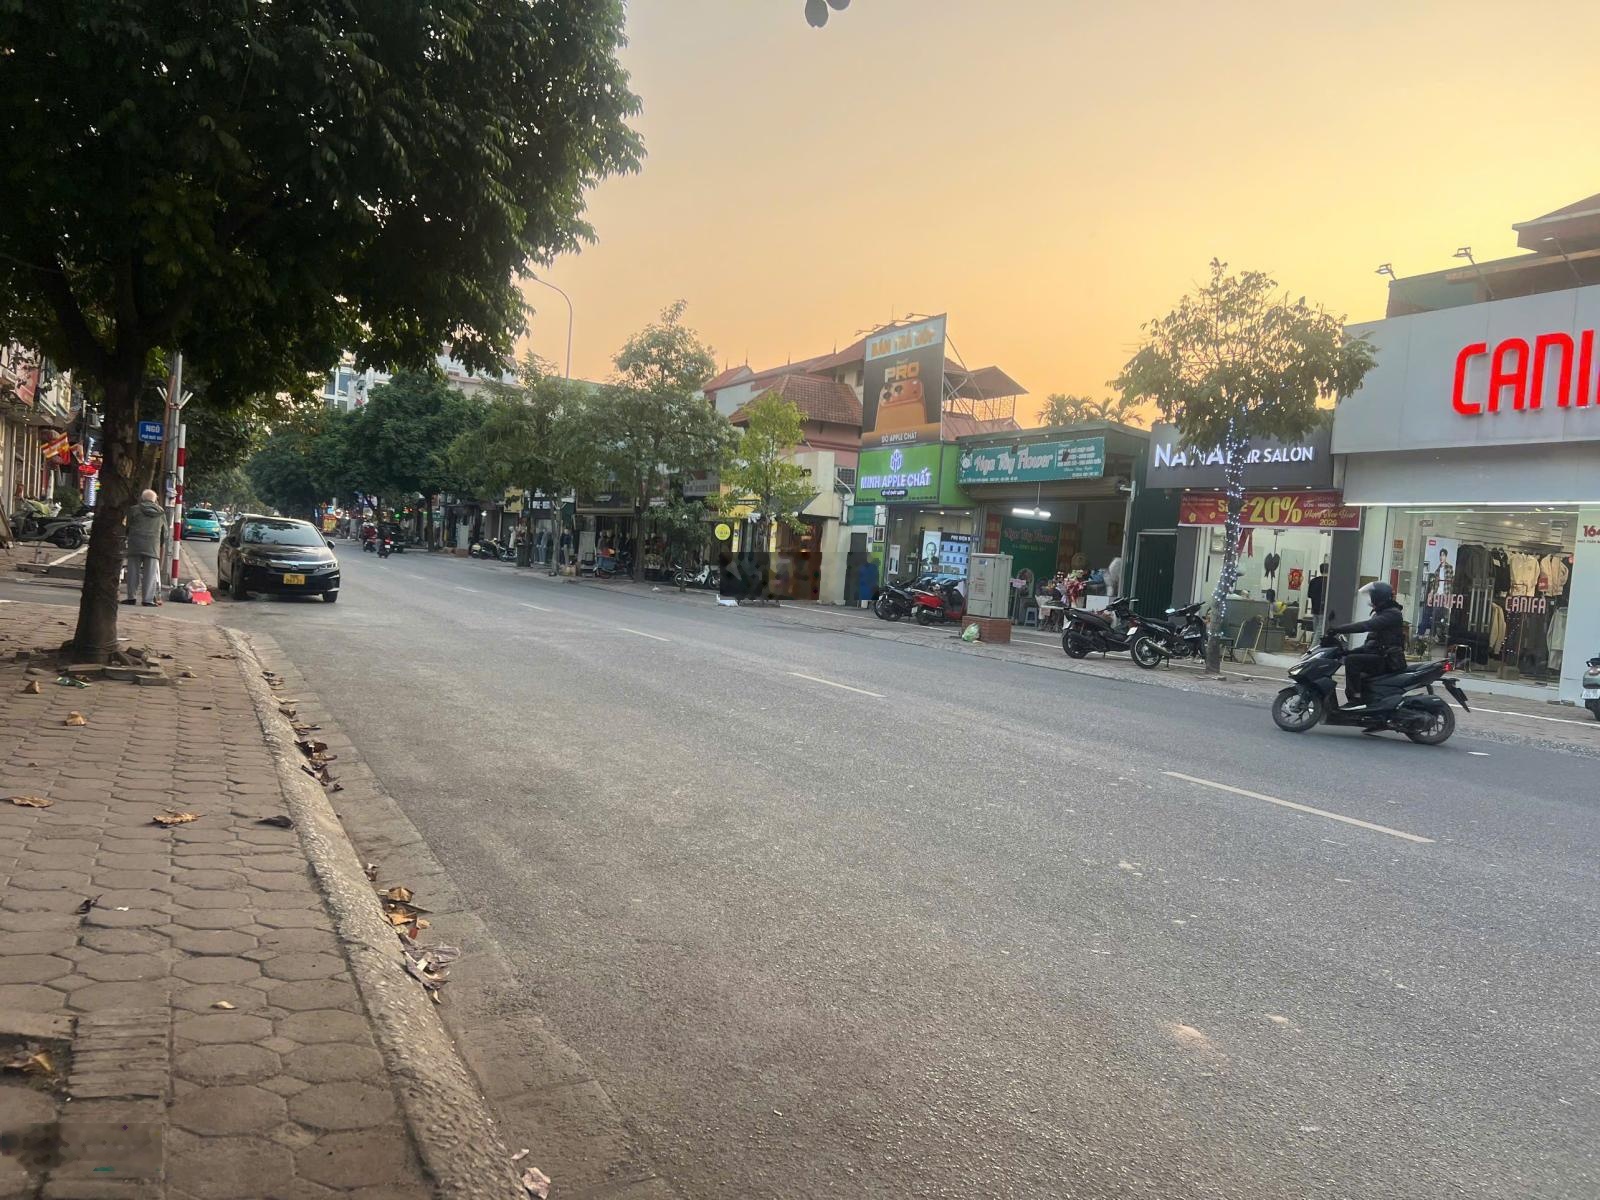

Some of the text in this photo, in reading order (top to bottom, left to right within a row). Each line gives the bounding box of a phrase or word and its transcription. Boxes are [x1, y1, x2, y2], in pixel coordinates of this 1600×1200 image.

[884, 361, 919, 384] PRO
[1452, 328, 1600, 416] CANI
[1017, 446, 1054, 470] Flower
[1263, 446, 1314, 463] SALON
[860, 475, 881, 489] MINH
[881, 473, 907, 487] APPLE
[1504, 595, 1547, 614] CANIFA
